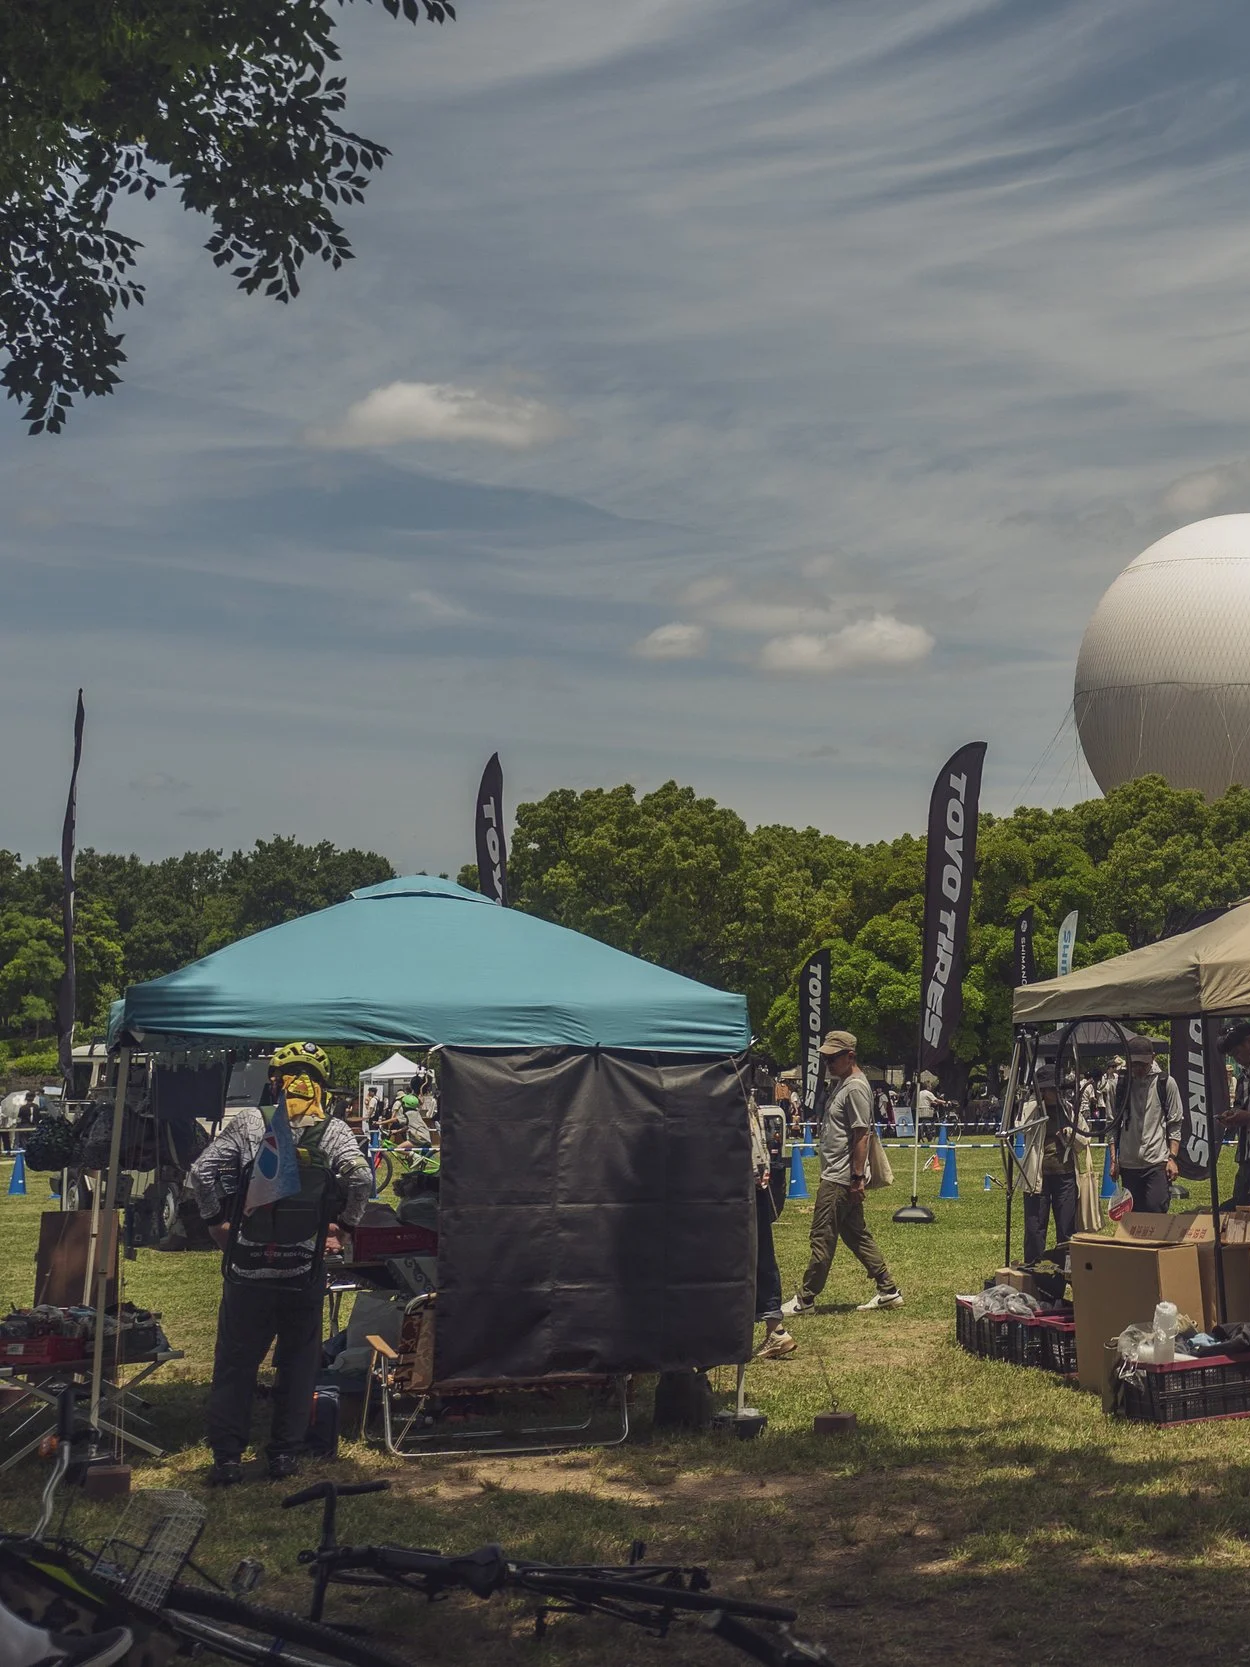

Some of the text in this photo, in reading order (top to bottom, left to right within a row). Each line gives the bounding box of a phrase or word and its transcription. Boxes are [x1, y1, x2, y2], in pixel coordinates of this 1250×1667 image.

[482, 796, 503, 905] TOY
[923, 772, 967, 1049] TOYO TIRES
[804, 963, 822, 1110] TOYO TIRES
[1187, 1050, 1209, 1168] TIRES
